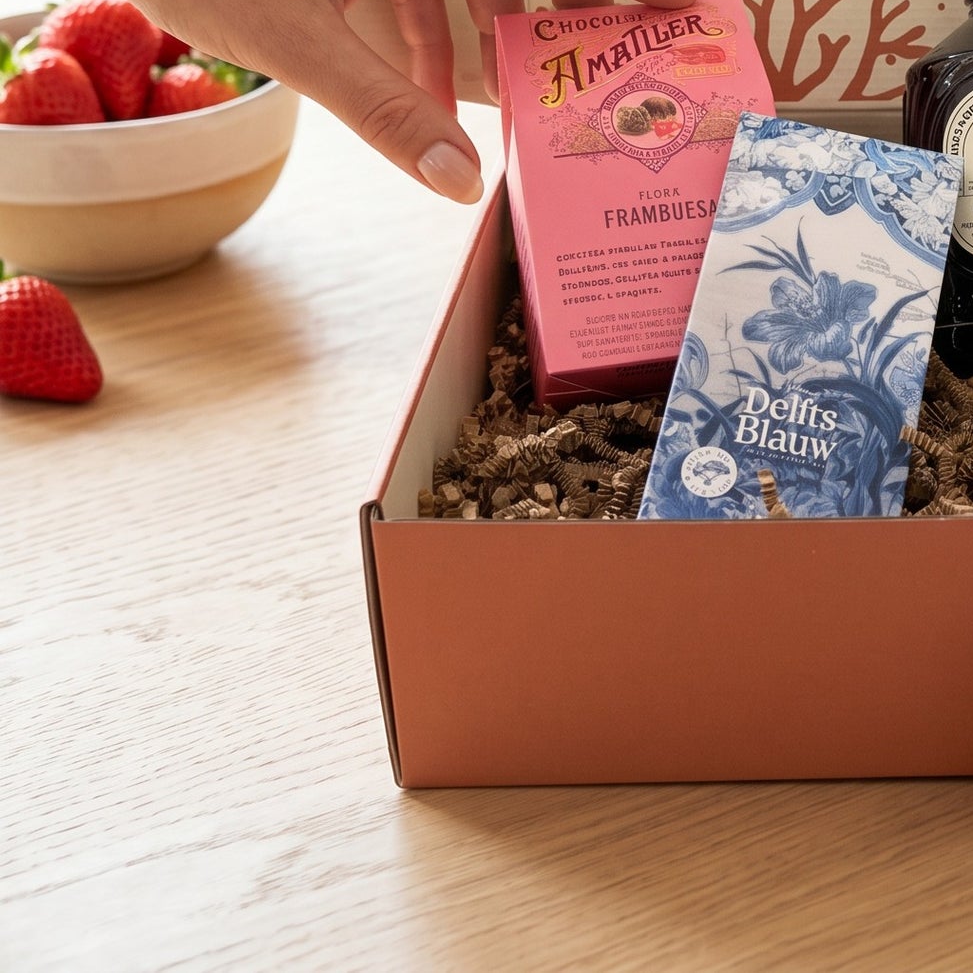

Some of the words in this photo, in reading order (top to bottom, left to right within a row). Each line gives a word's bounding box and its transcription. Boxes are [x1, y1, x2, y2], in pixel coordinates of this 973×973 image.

[604, 199, 718, 229] FRAMBUESA
[743, 387, 838, 431] Delfts
[734, 414, 838, 461] Blauw
